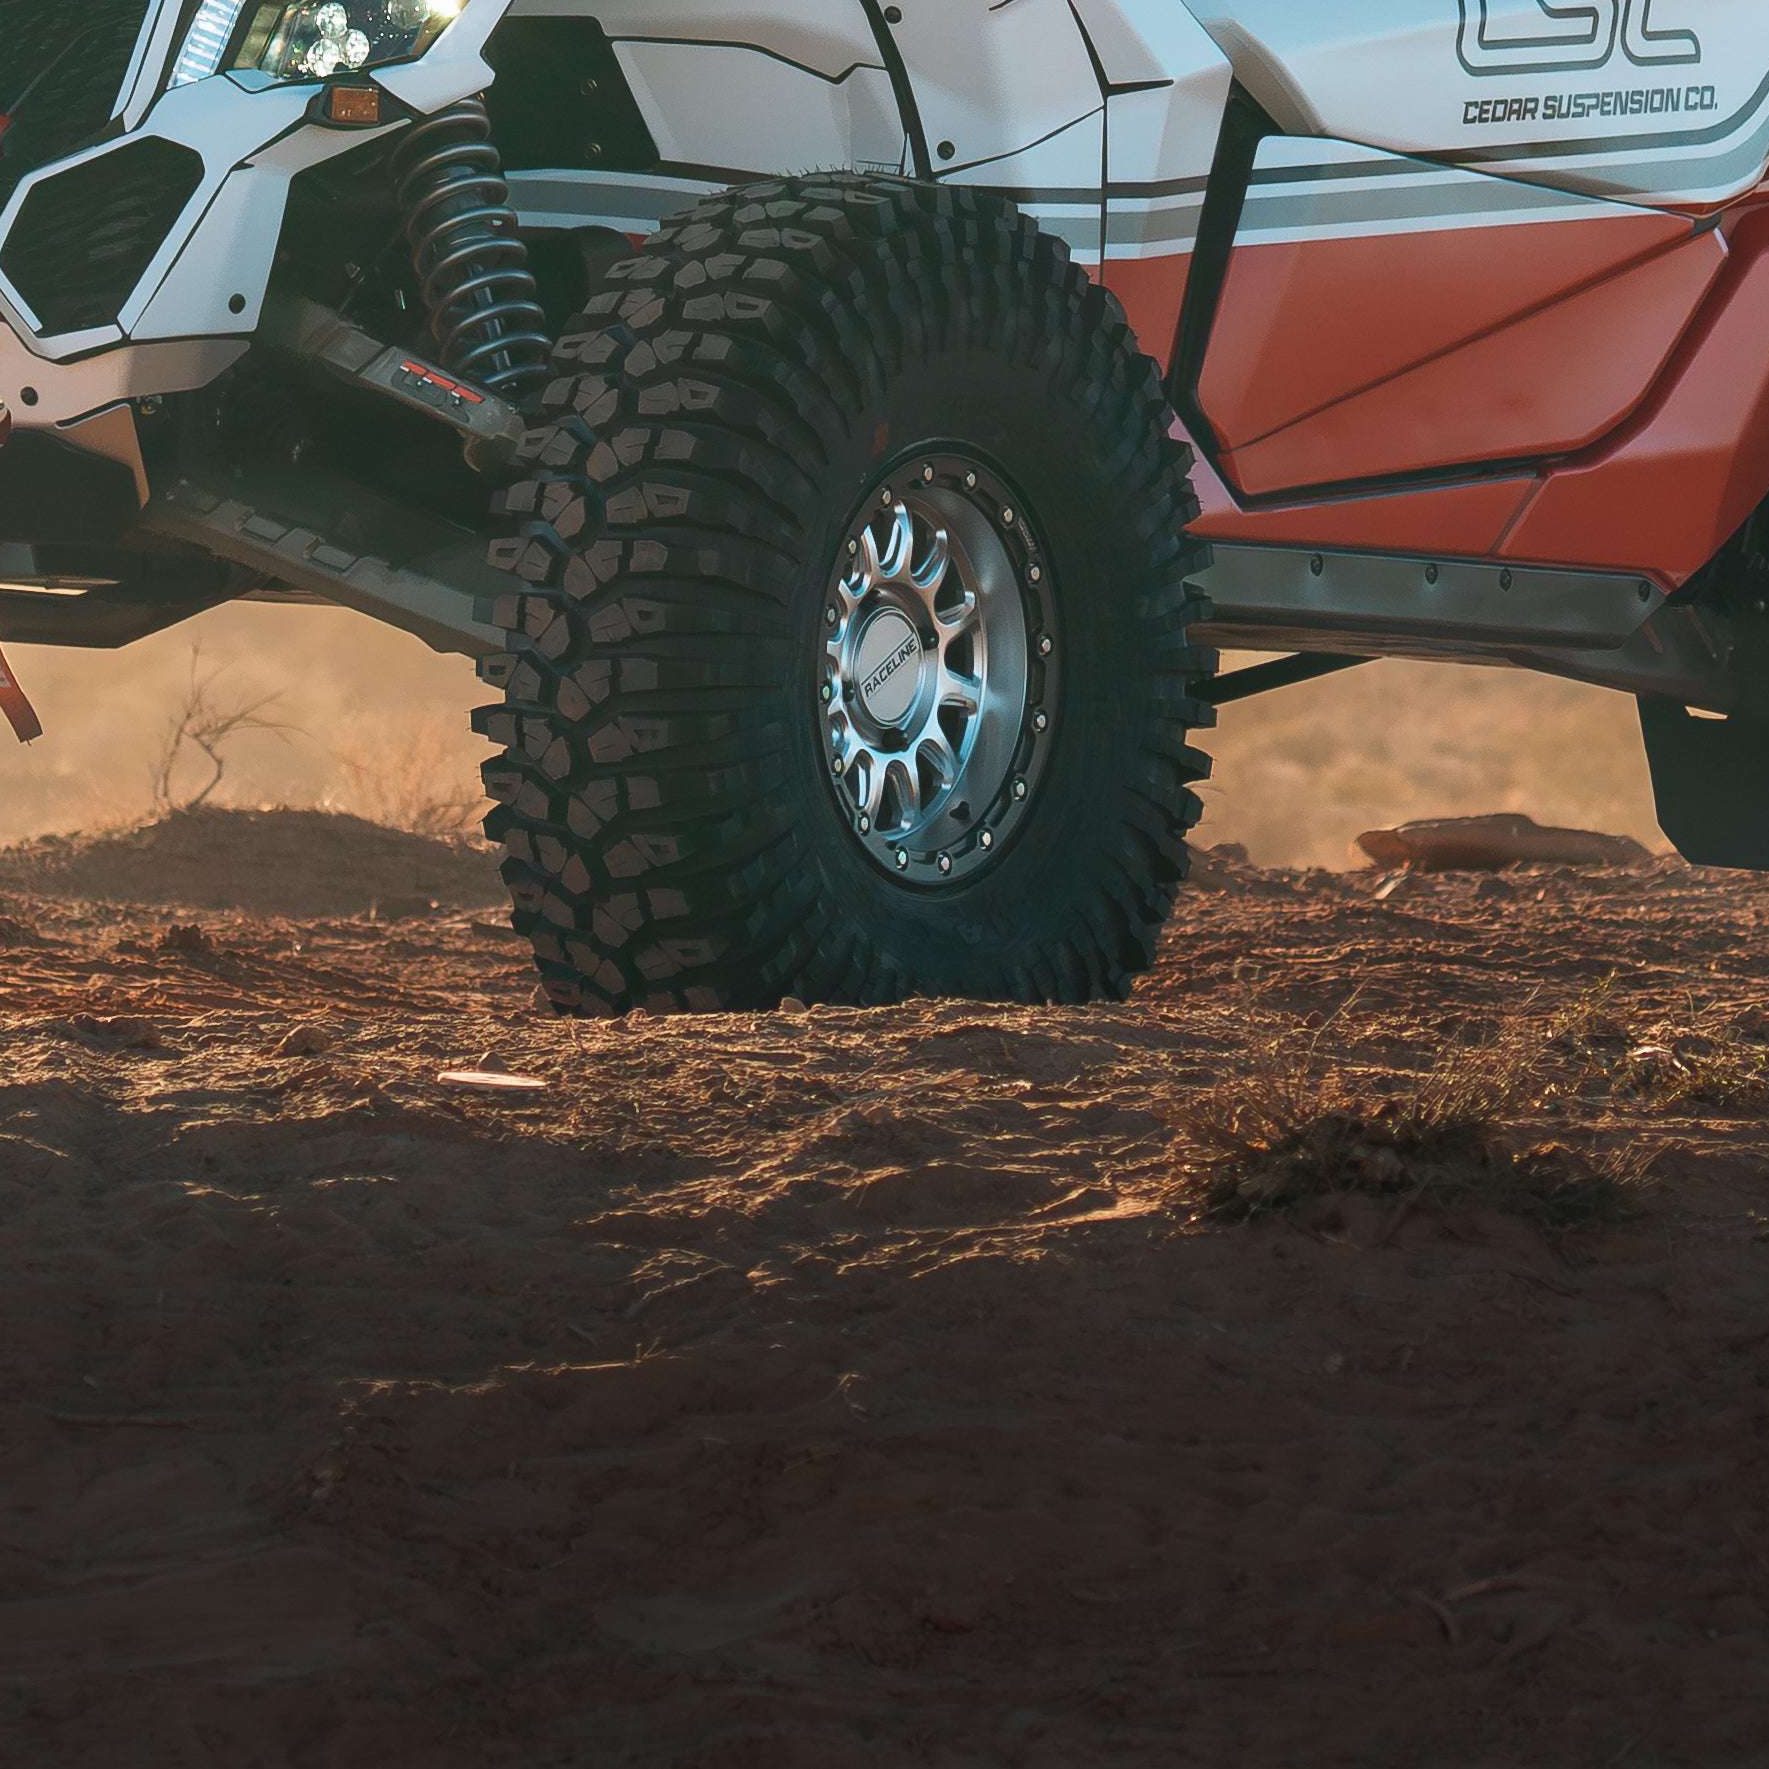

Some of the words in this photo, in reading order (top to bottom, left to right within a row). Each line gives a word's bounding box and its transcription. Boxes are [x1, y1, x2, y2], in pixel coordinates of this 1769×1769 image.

[1462, 97, 1539, 125] CEDAR
[1541, 89, 1682, 120] SUSPENSION
[1684, 86, 1718, 112] CO.
[864, 637, 918, 698] RACELINE
